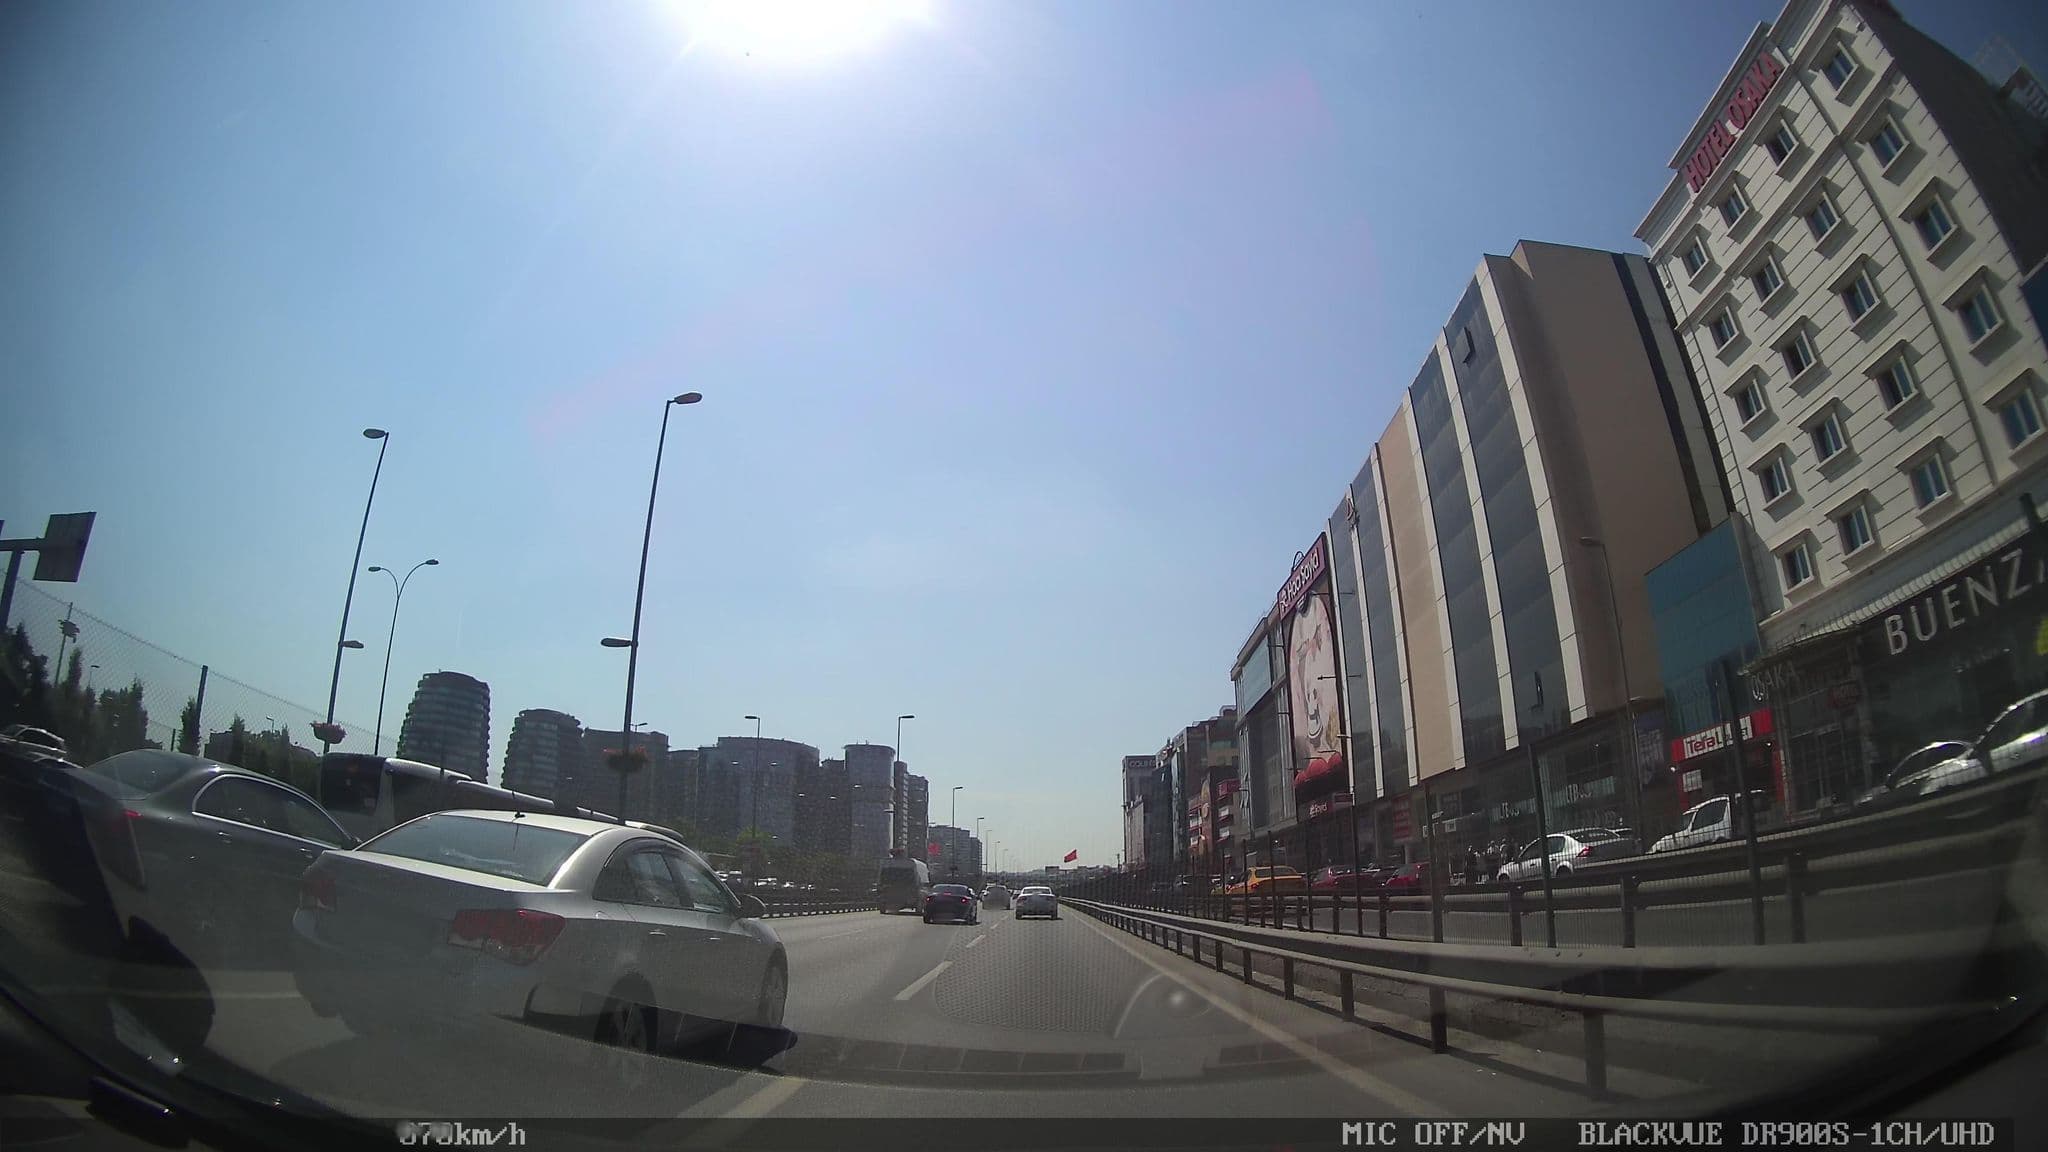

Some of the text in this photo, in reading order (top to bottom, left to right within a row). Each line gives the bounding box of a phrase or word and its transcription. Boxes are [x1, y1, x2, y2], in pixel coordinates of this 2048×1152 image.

[1685, 51, 1785, 193] HOTEL OSAKA
[1885, 547, 2045, 656] BUENZ
